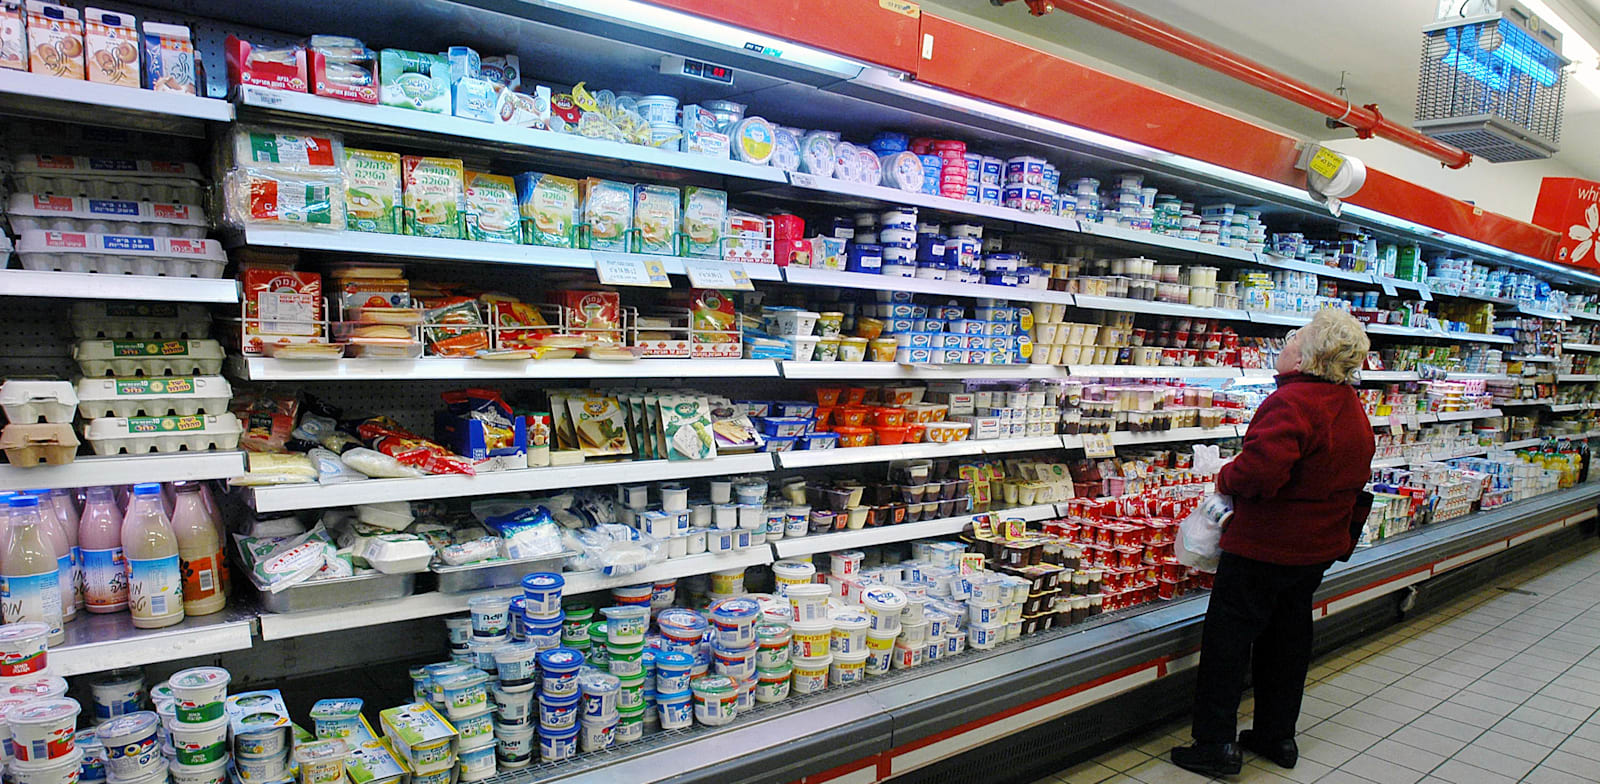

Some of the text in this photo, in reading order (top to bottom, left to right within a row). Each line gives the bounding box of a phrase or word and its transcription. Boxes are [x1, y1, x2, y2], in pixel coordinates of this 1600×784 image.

[355, 160, 393, 170] הצהובה
[354, 170, 386, 180] הטובה
[422, 168, 457, 177] הצהובה
[421, 177, 450, 186] הטובה
[479, 190, 505, 199] הטובה
[542, 192, 567, 201] הטובה
[1578, 185, 1600, 202] whi
[274, 278, 298, 288] עמק
[168, 384, 190, 392] מהלול
[178, 421, 201, 429] מהלול
